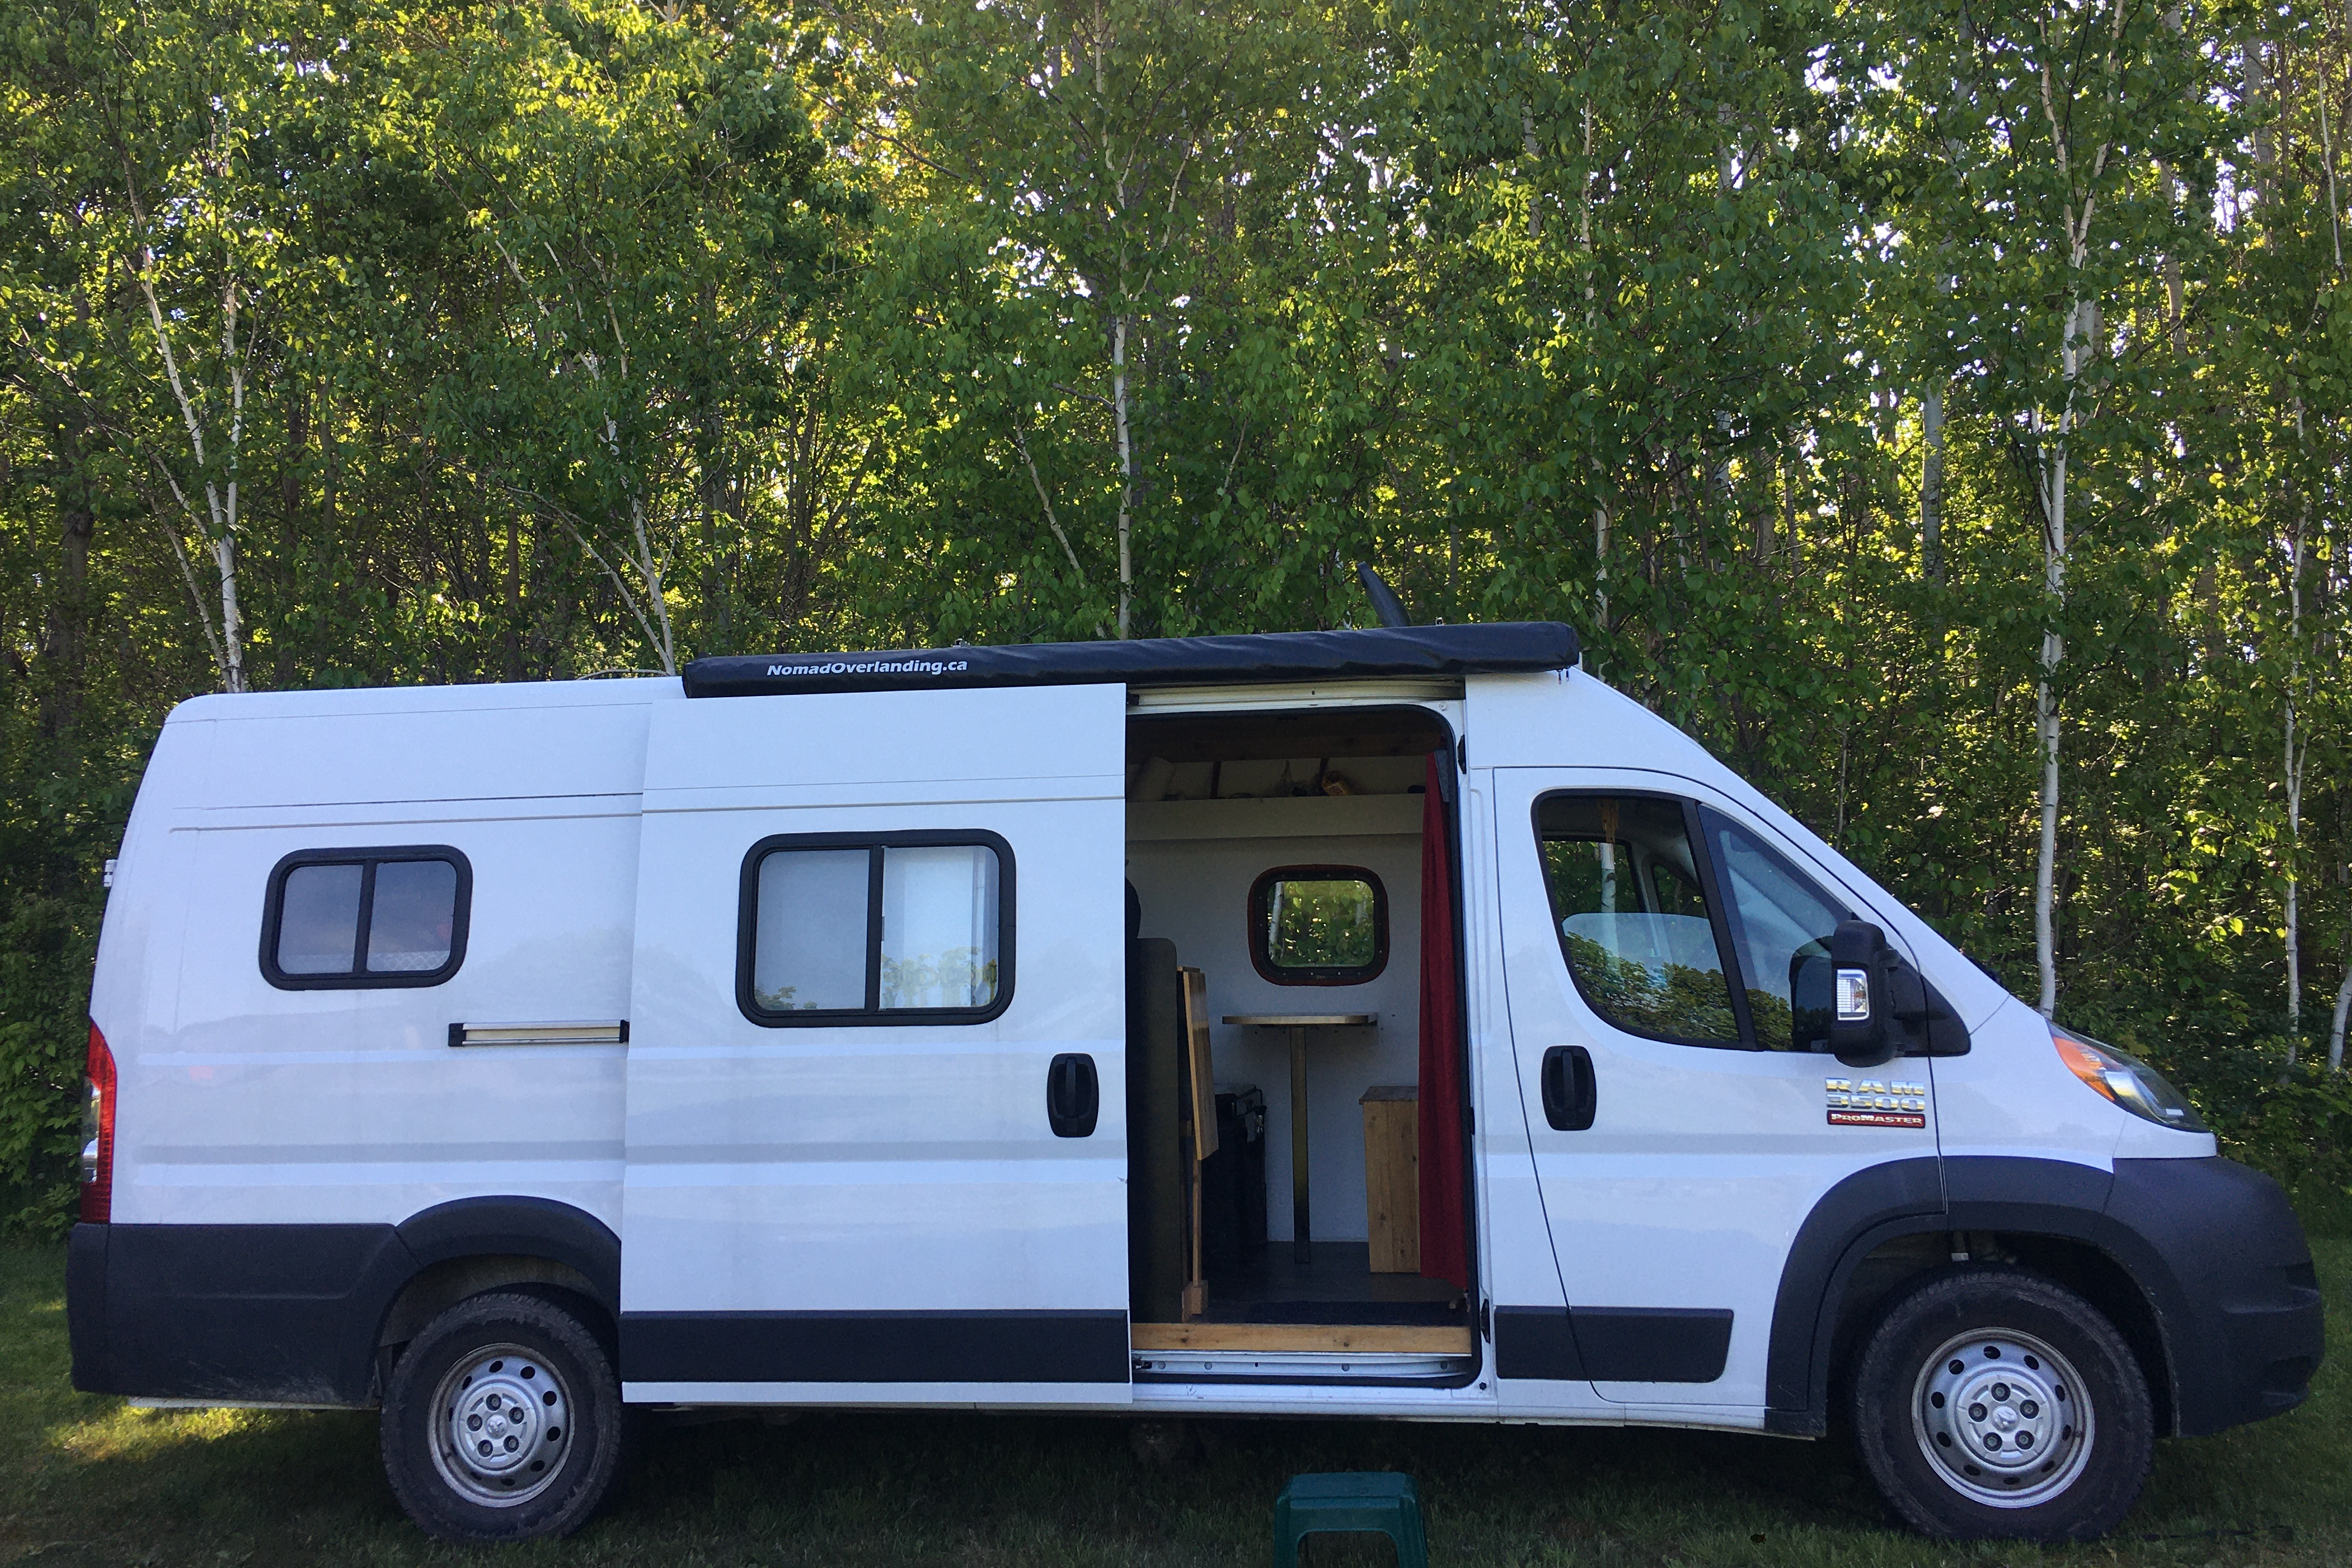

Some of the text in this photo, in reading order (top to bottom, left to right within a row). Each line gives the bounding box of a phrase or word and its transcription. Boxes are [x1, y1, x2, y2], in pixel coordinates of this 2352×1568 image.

[767, 660, 968, 675] NomadOverlanding.ca
[1825, 1078, 1925, 1095] RAM
[1827, 1094, 1925, 1112] 3500
